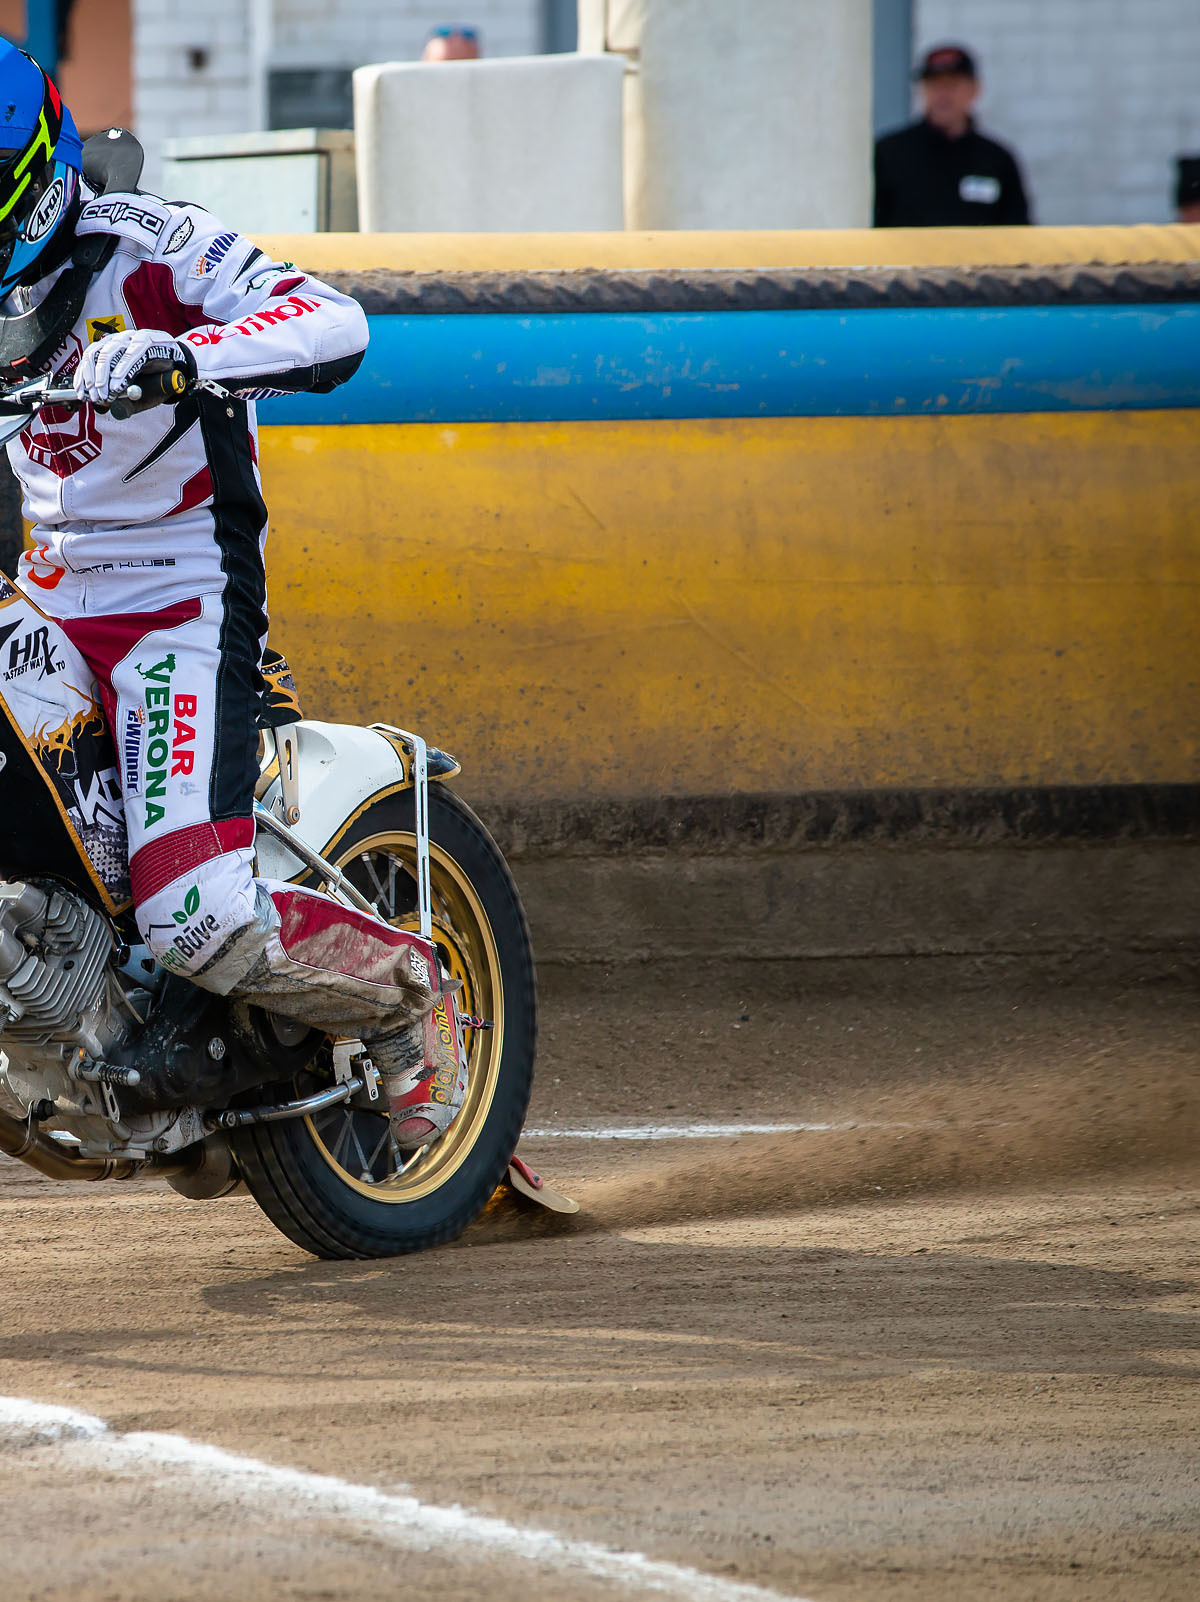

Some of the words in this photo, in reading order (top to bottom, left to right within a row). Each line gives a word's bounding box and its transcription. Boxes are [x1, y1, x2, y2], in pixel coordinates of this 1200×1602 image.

[30, 184, 60, 240] Arai
[119, 558, 177, 569] KLUBS
[3, 662, 29, 682] ASTEST
[29, 656, 44, 671] WAY
[55, 660, 66, 672] TO
[135, 653, 177, 830] VERONA
[170, 693, 197, 778] BAR
